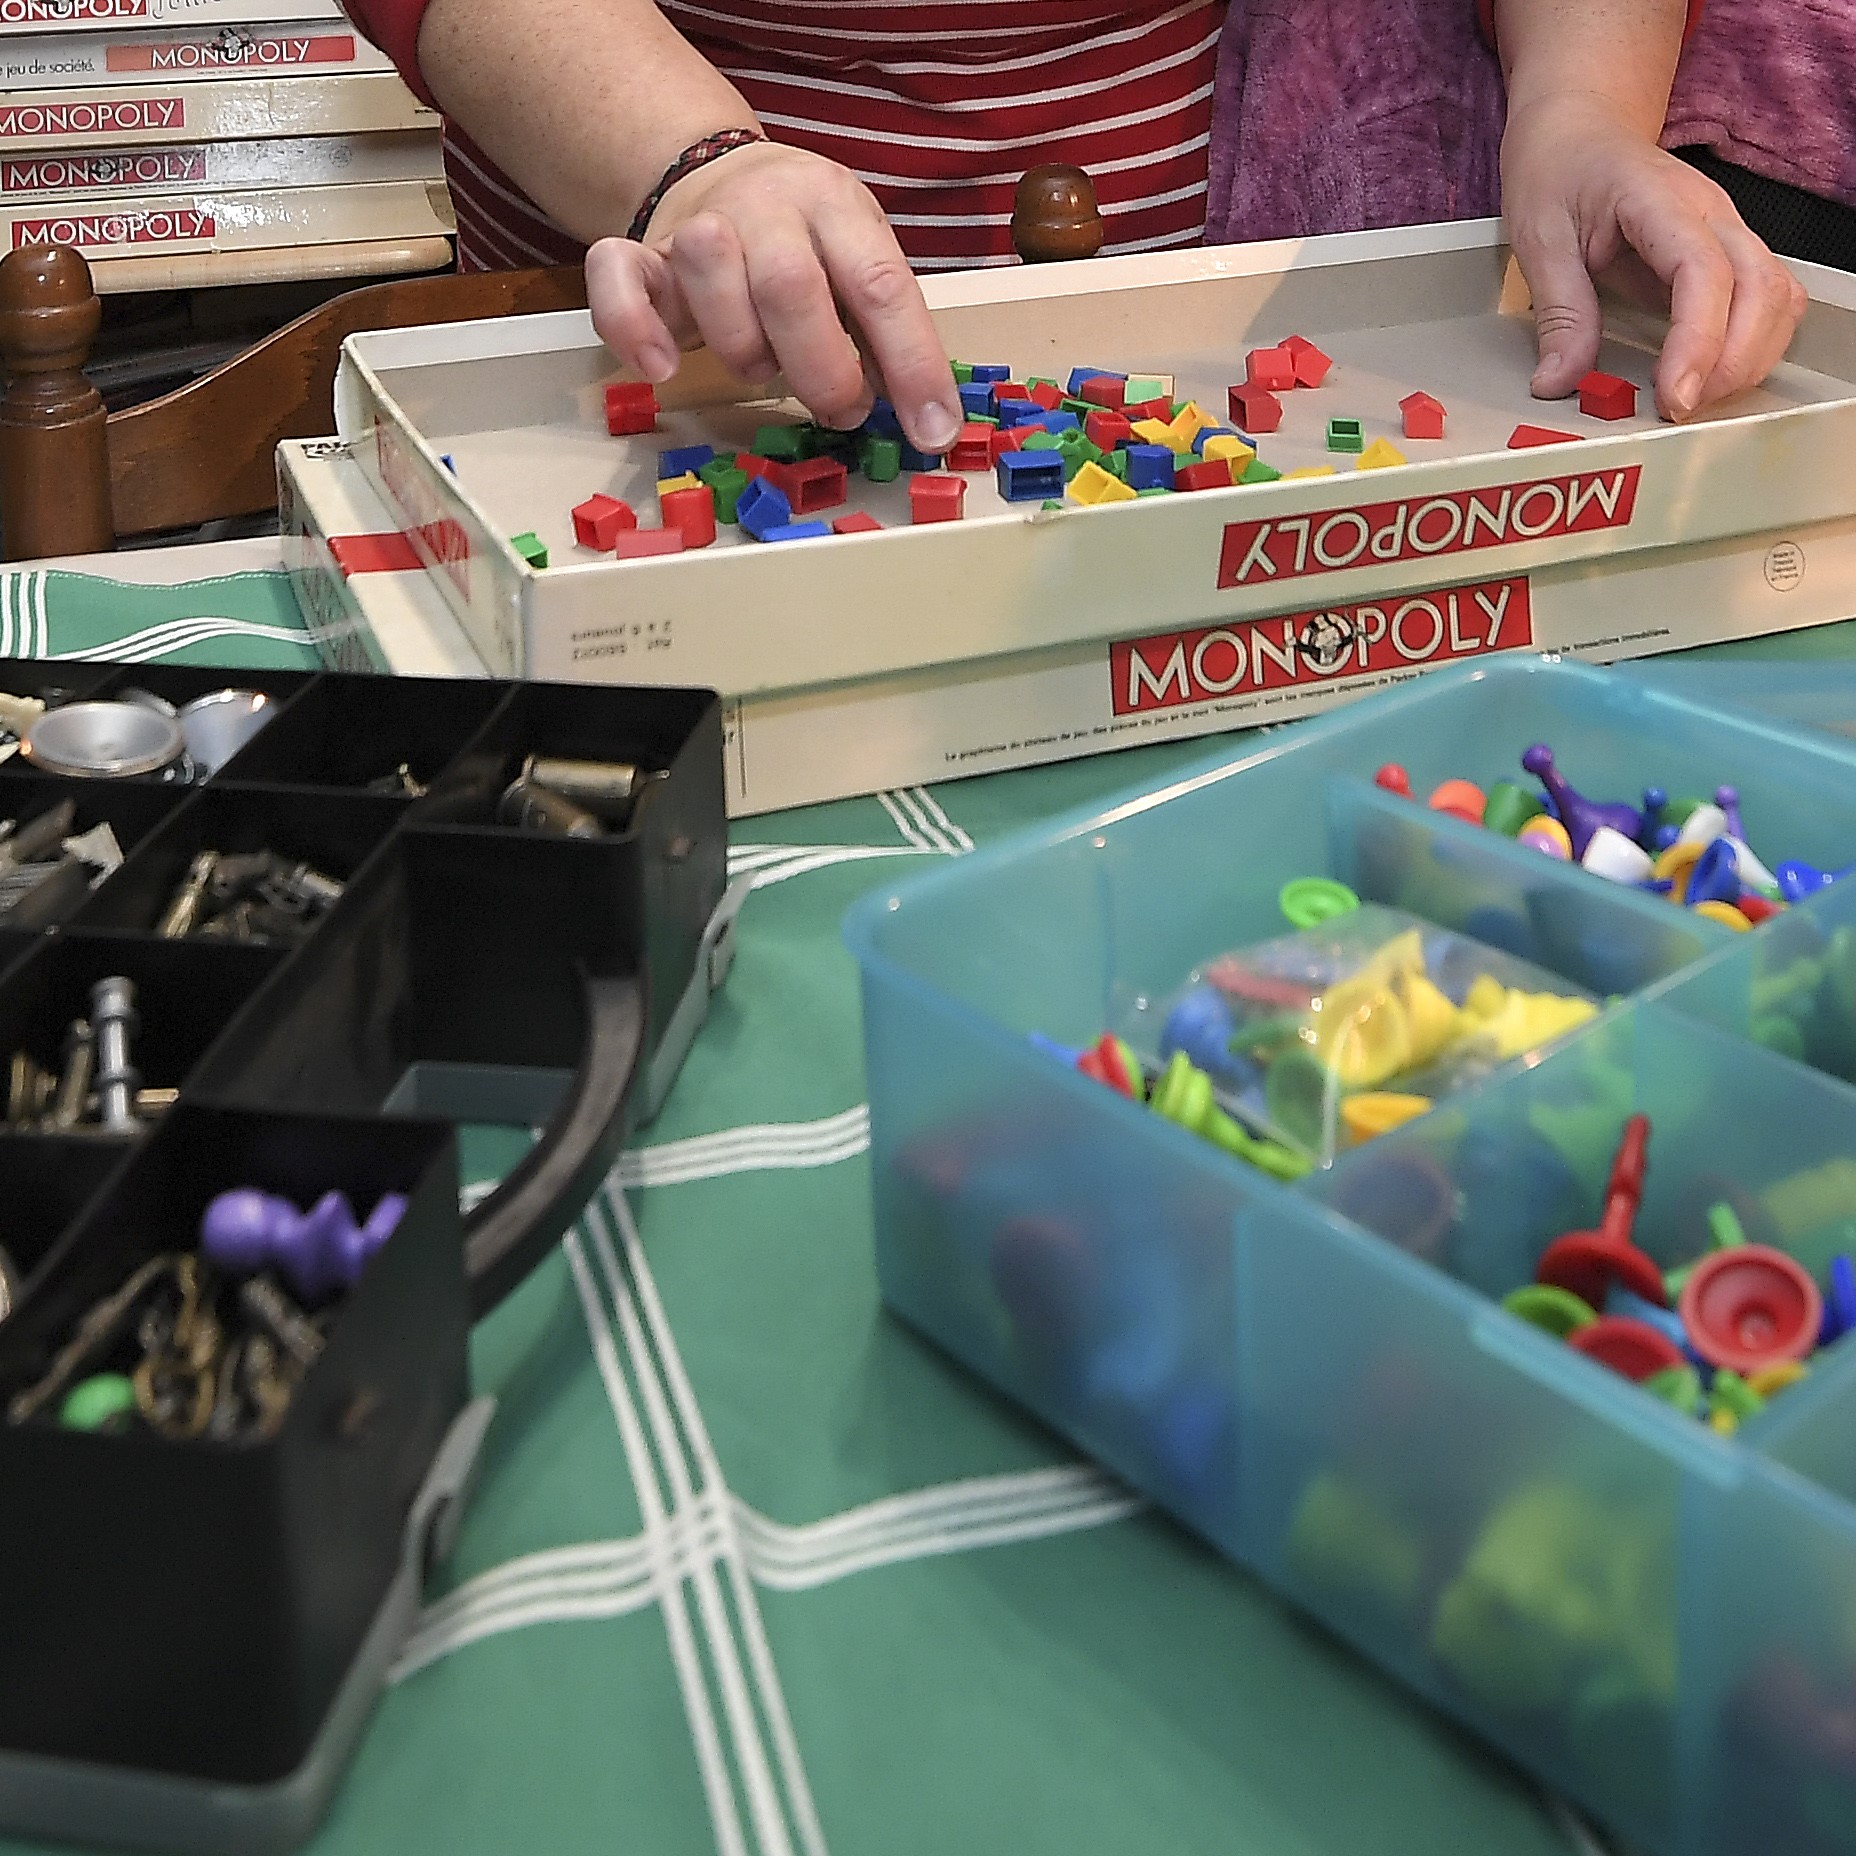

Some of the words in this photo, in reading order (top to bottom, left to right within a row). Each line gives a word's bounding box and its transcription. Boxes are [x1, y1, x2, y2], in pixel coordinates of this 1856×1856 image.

[46, 56, 96, 76] société.
[150, 38, 311, 67] MONOPOLY
[9, 153, 199, 184] MONOPOLY
[19, 208, 208, 246] MONOPOLY
[1234, 470, 1628, 583] MONOPOLY
[1128, 583, 1512, 707] MONOPOLY
